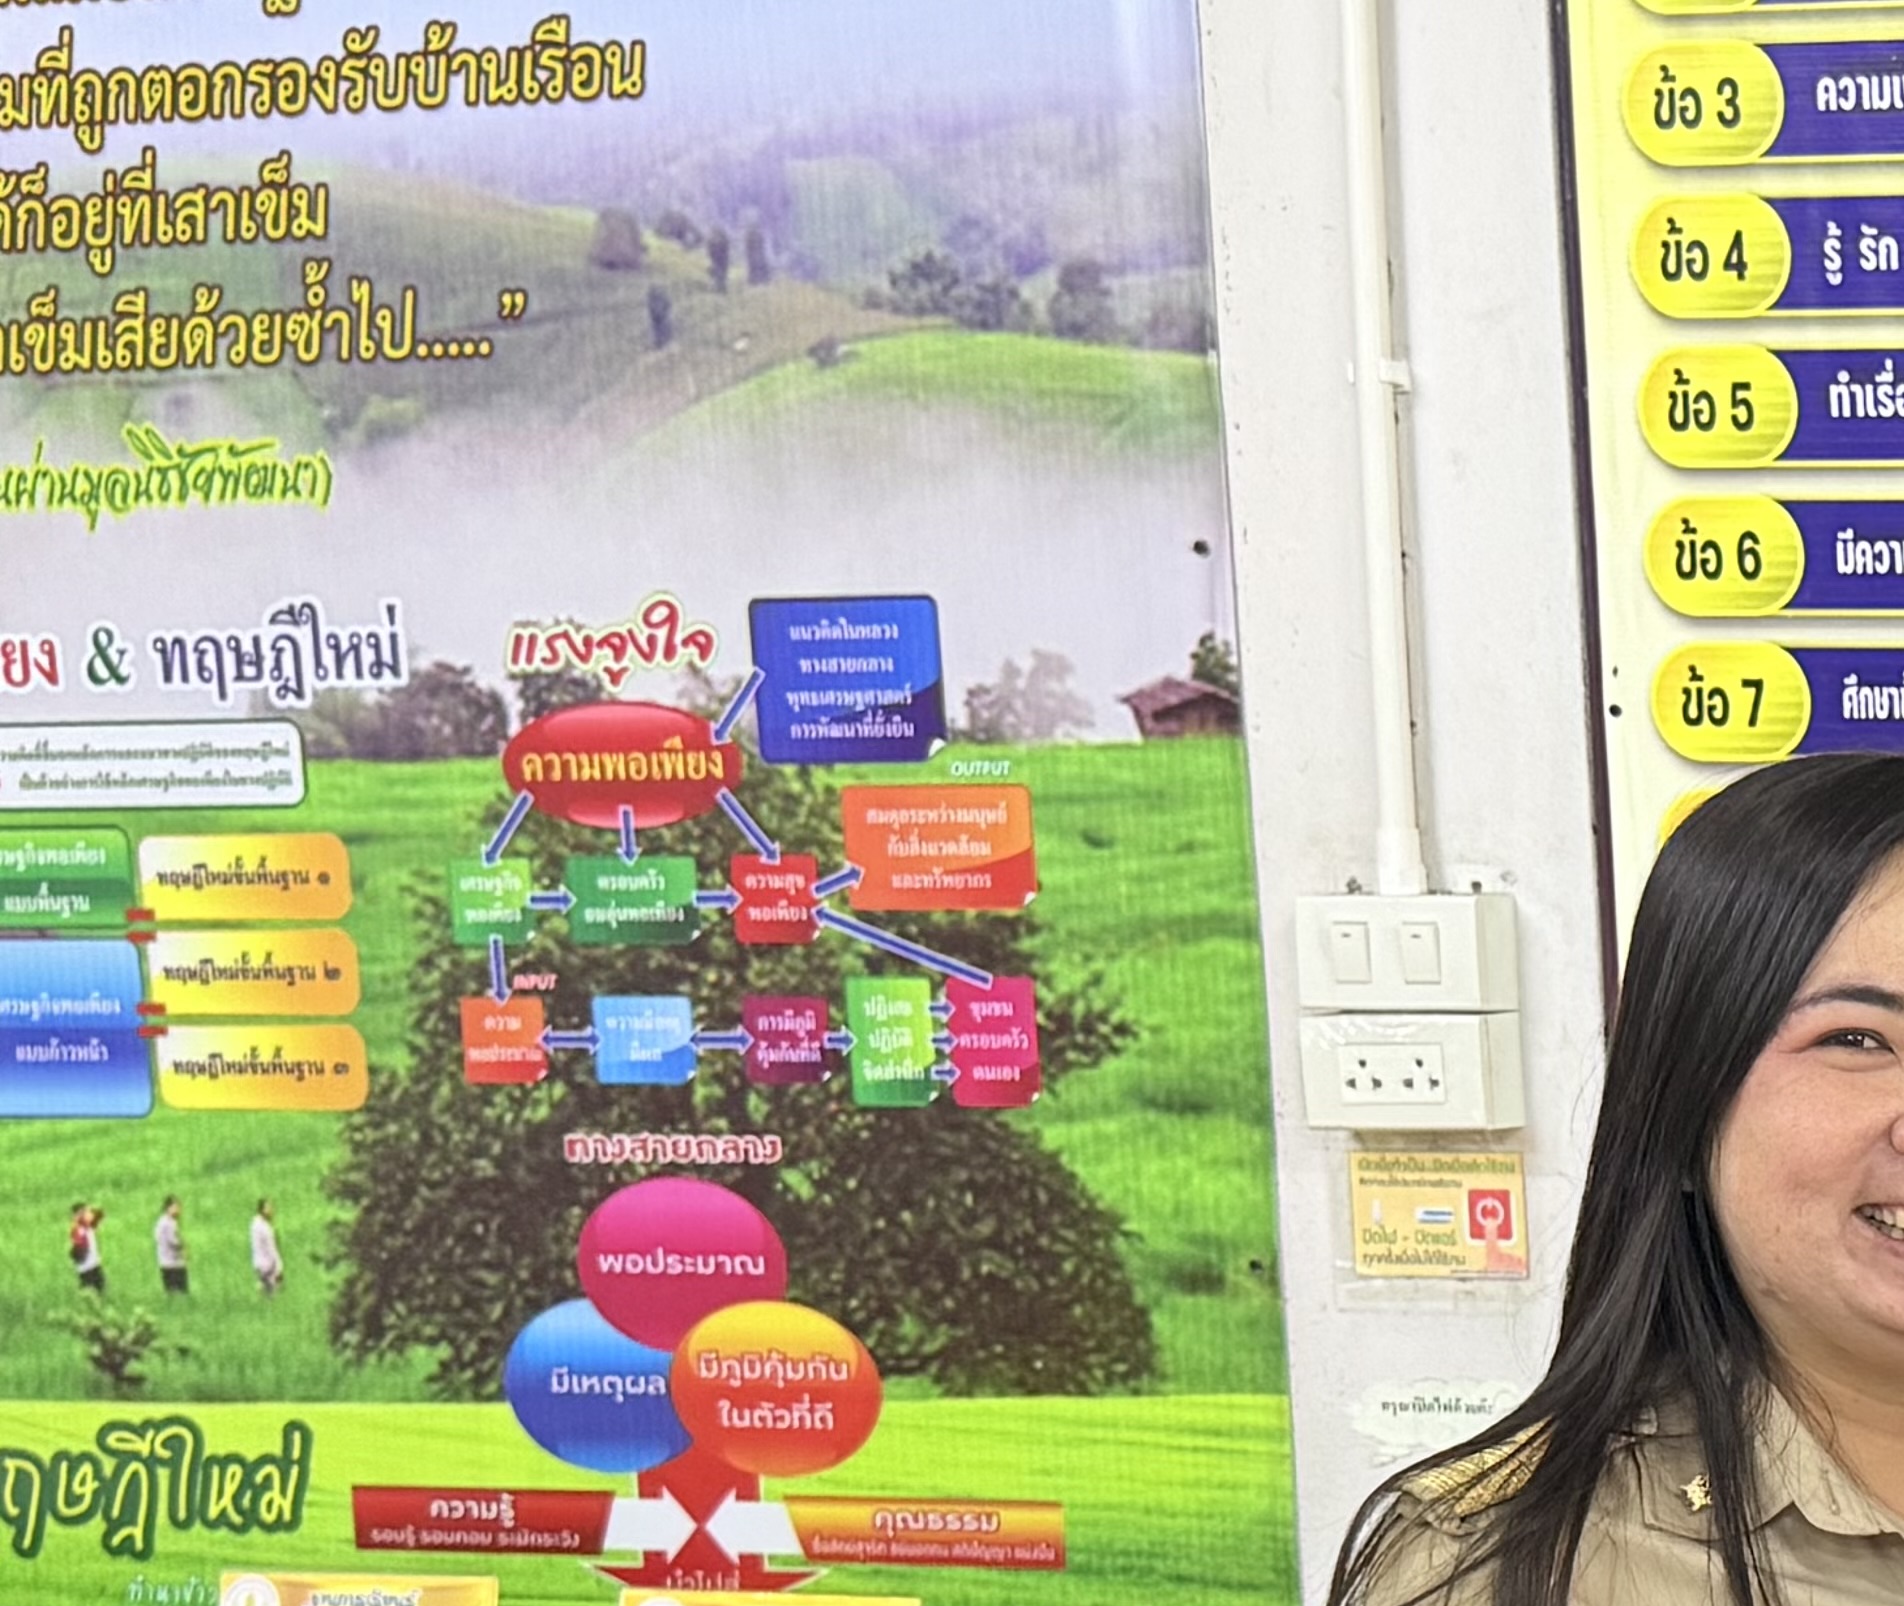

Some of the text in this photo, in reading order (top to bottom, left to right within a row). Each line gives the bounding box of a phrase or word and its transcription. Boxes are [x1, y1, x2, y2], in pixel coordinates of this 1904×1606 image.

[1653, 65, 1741, 128] ข้อ 3
[1661, 217, 1747, 281] ข้อ 4
[1823, 223, 1843, 286] รู้
[1860, 224, 1898, 272] รัก
[1668, 369, 1754, 432] ข้อ 5
[1675, 518, 1762, 583] ข้อ 6
[87, 627, 130, 686] &
[153, 602, 402, 702] ทฤษฎีใหม่
[511, 599, 714, 684] แรงจูงใจ
[1682, 664, 1765, 729] ข้อ 7
[522, 736, 725, 783] ความพอเพียง
[951, 760, 1011, 776] OUTPUT
[513, 974, 559, 990] INPUT
[563, 1131, 782, 1166] ทางสายกลาง
[597, 1247, 766, 1279] พอประมาณ
[550, 1365, 668, 1402] มีเหตุผล
[697, 1350, 850, 1392] มีภูมิคุ้มกัน
[717, 1395, 834, 1434] ในตัวที่ดี
[430, 1492, 515, 1528] ความรู้
[874, 1510, 999, 1538] คุณธรรม
